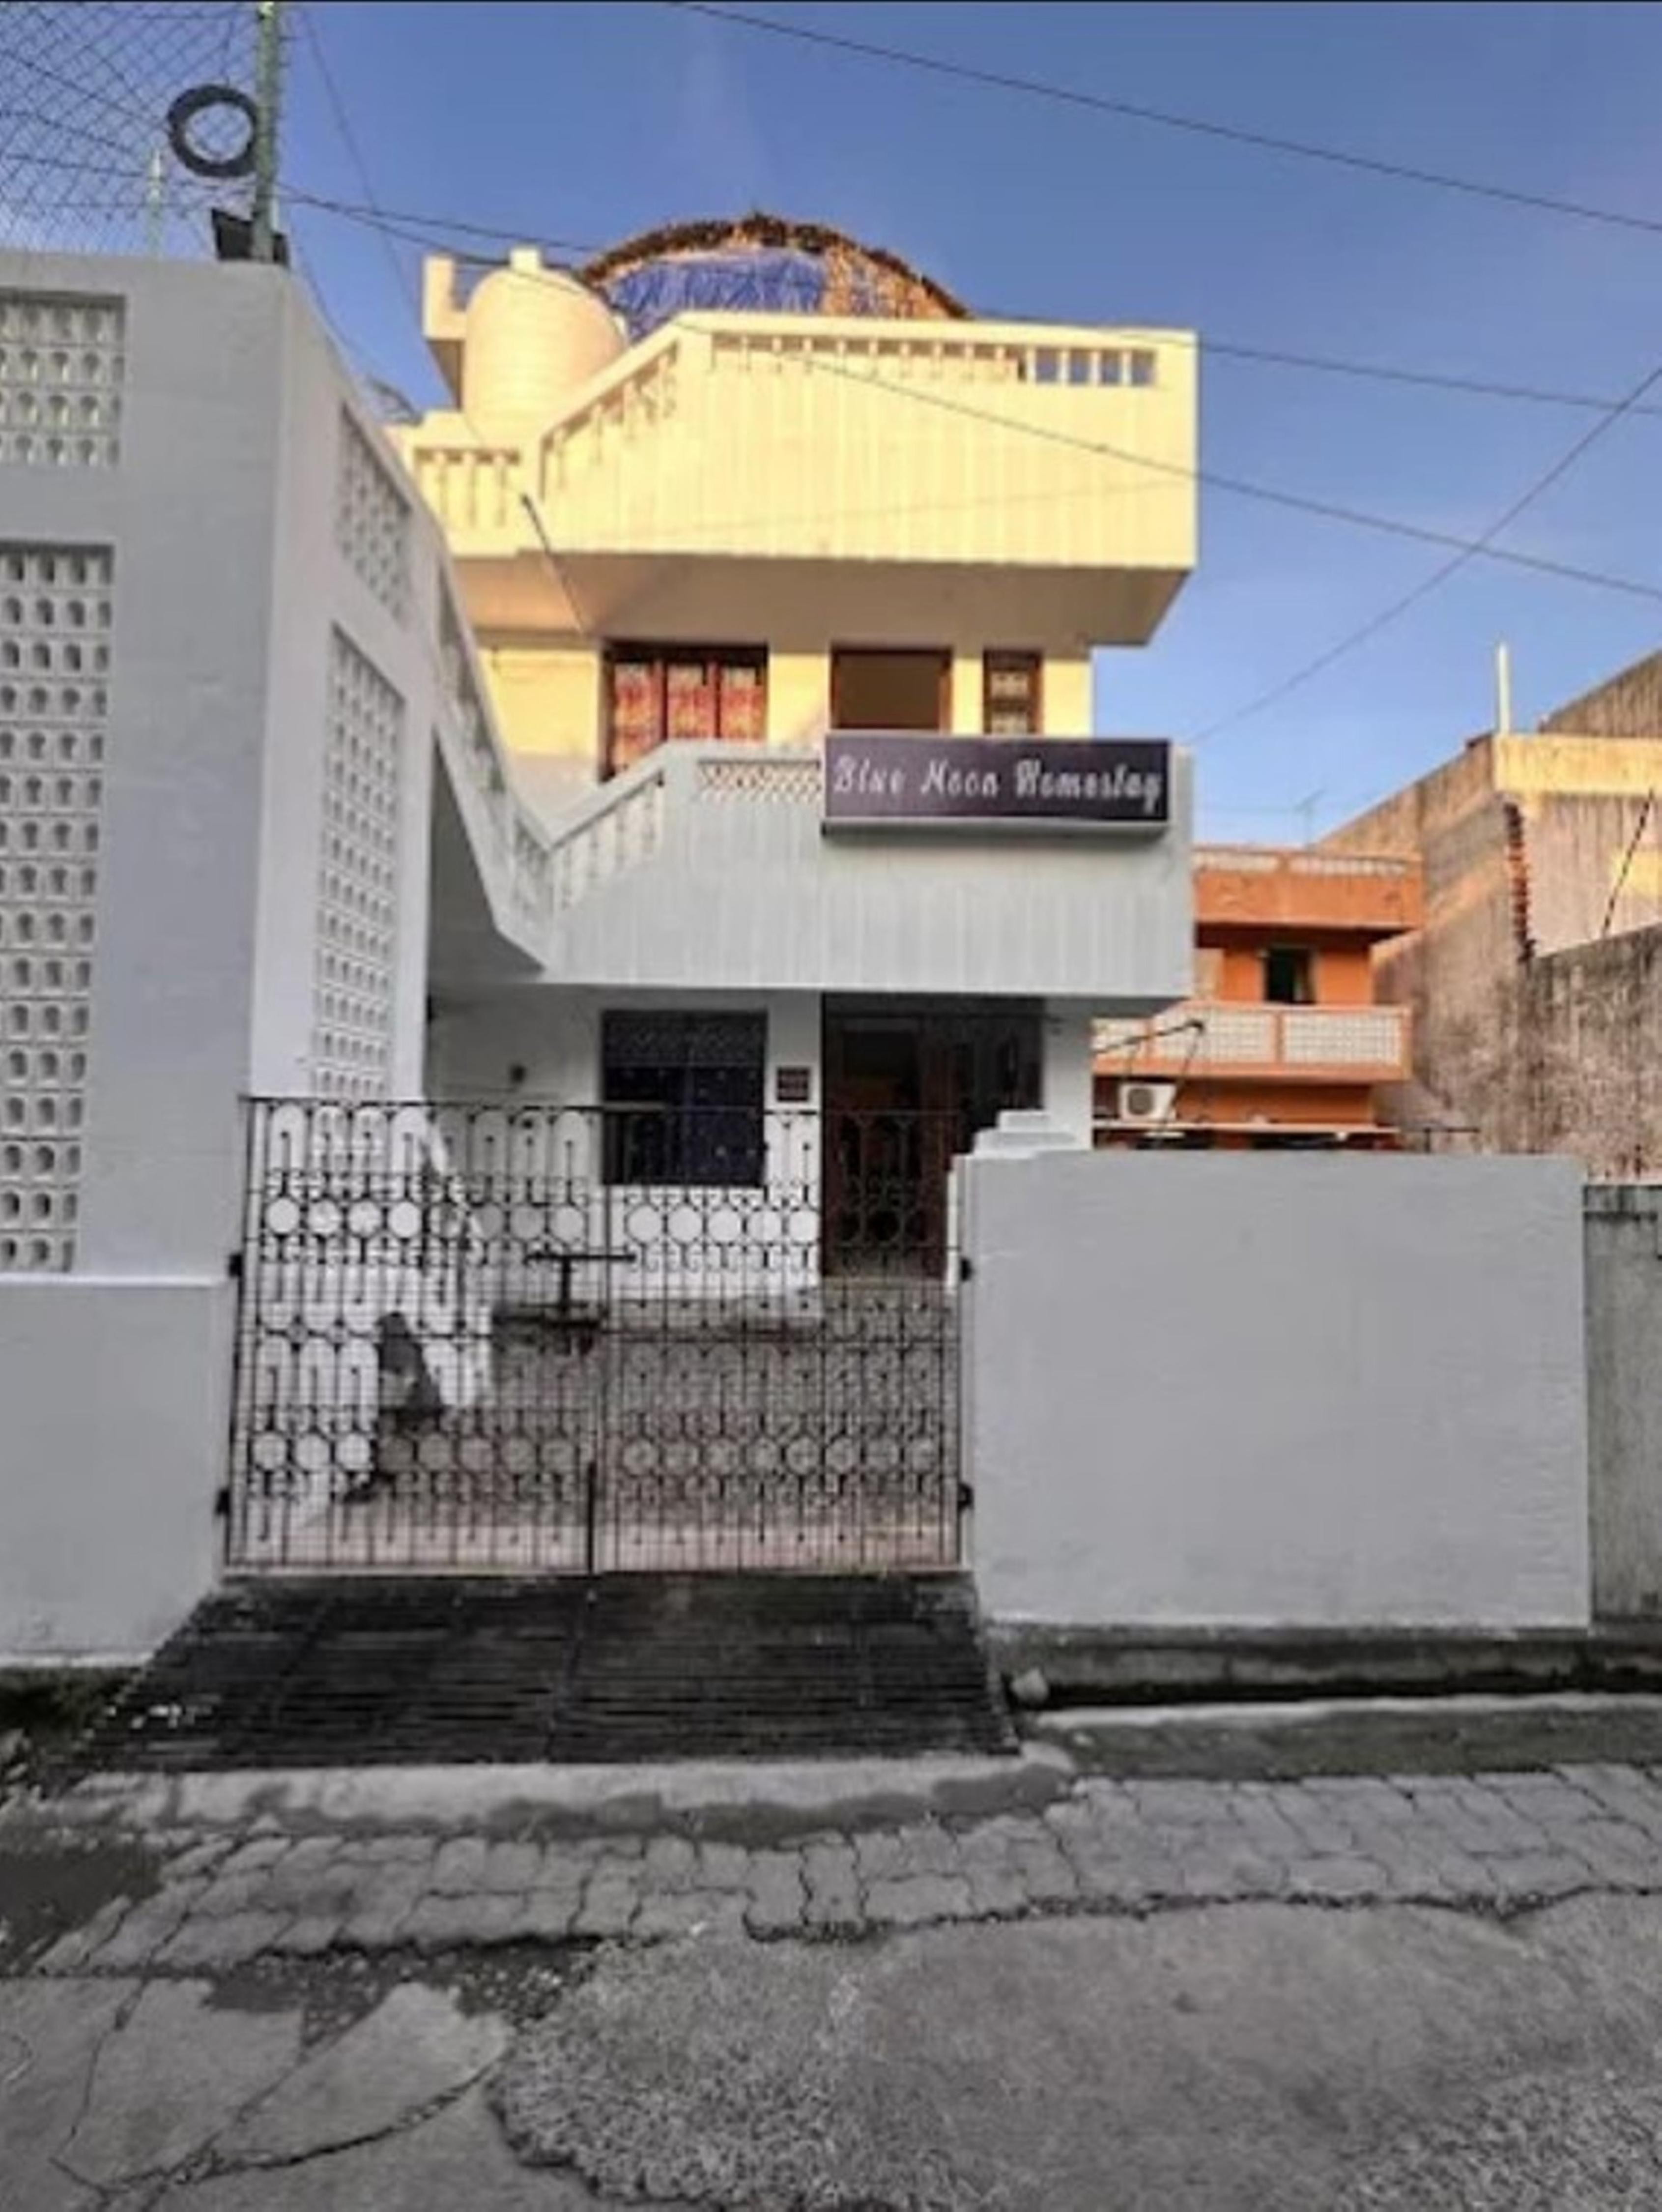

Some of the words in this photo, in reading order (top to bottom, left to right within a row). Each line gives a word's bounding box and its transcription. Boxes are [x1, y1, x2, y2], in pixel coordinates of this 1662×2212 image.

[834, 754, 905, 794] Blue
[920, 757, 1000, 797] Moon
[1014, 758, 1162, 814] Homestay
